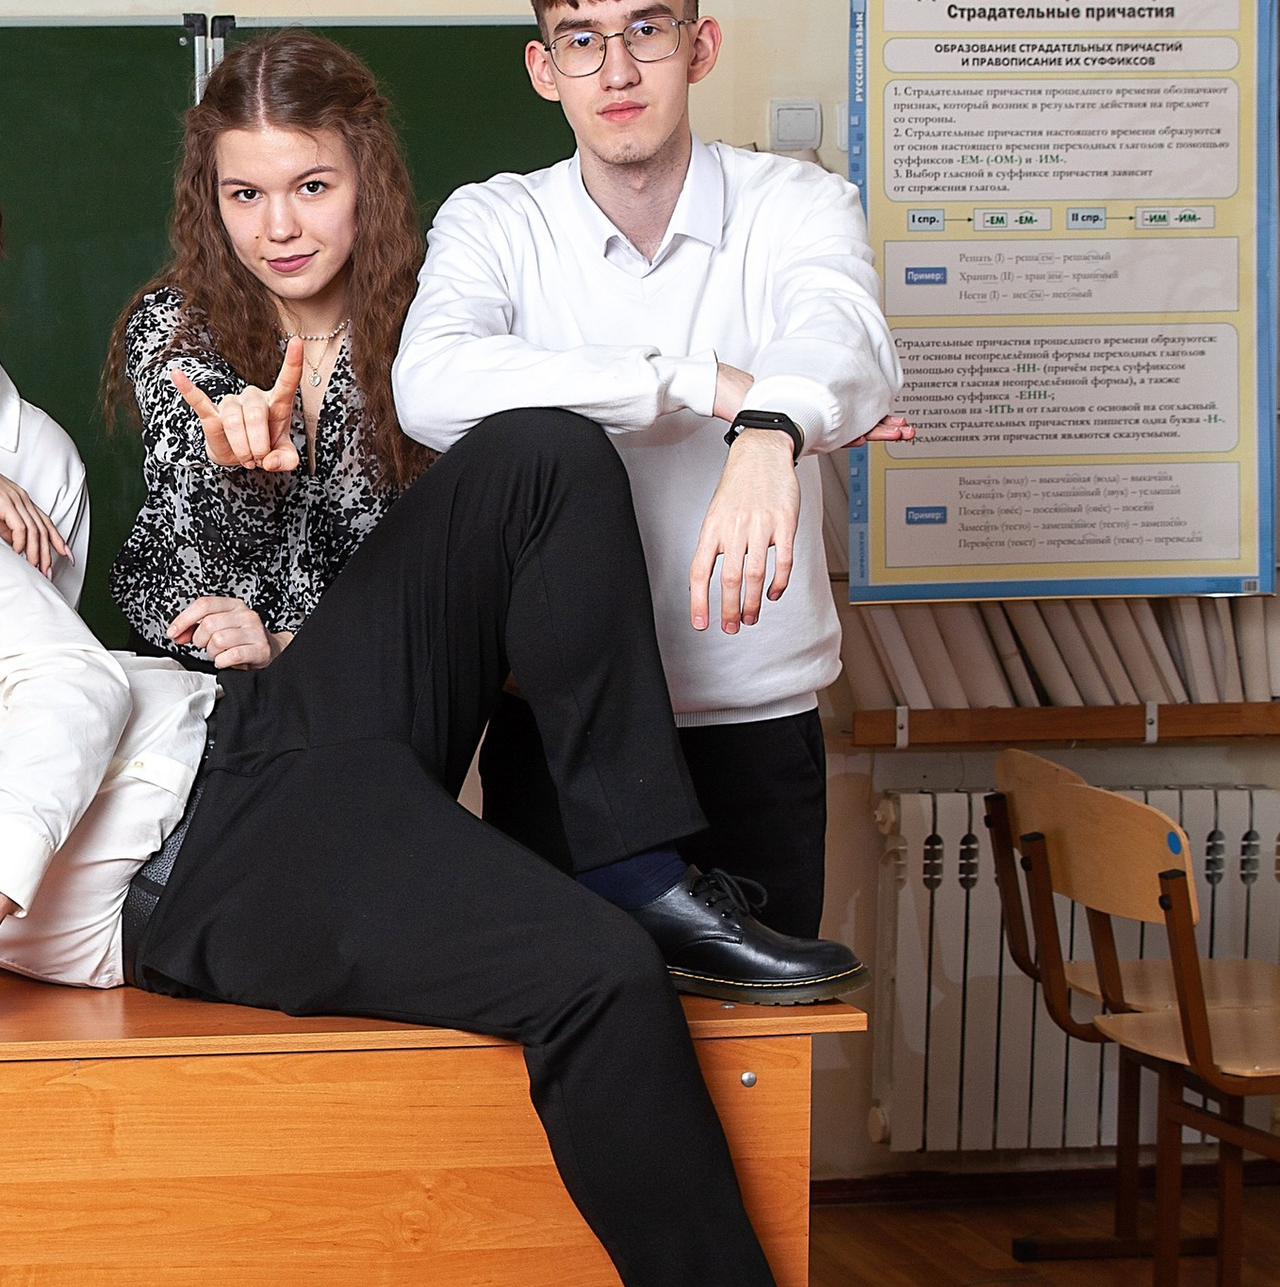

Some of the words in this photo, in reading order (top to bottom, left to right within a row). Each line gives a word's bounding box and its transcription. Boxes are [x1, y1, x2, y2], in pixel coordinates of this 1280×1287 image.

[947, 4, 1080, 21] Страдательные
[1086, 6, 1175, 21] причастия
[855, 13, 864, 45] ЯЗЫК
[934, 44, 1017, 53] ОБРАЗОВАНИЕ
[1019, 43, 1113, 53] СТРАДАТЕЛЬНЫХ
[1116, 41, 1183, 52] ПРИЧАСТИЙ
[961, 58, 969, 66] И
[972, 58, 1062, 66] ПРАВОПИСАНИЕ
[1065, 57, 1080, 66] ИХ
[1084, 57, 1156, 66] СУФФИКСОВ
[855, 48, 864, 102] РУССКИЙ
[893, 87, 901, 96] 1.
[904, 87, 983, 98] Страдательные
[986, 88, 1042, 99] причастия
[1045, 88, 1113, 99] прошедшего
[1116, 88, 1161, 98] времени
[893, 102, 941, 112] признак,
[943, 101, 989, 112] который
[991, 102, 1029, 110] возник
[1040, 101, 1096, 112] результате
[1099, 100, 1147, 110] действия
[1150, 101, 1163, 109] на
[908, 116, 957, 126] стороны.
[893, 128, 902, 137] 2.
[905, 128, 984, 139] Страдательные
[987, 129, 1043, 139] причастия
[1046, 128, 1108, 137] настоящего
[1110, 128, 1156, 139] времени
[908, 143, 938, 151] основ
[941, 143, 1002, 151] настоящего
[1005, 143, 1050, 153] времени
[893, 156, 954, 168] суффиксов
[957, 155, 983, 164] -ЕМ-
[986, 154, 1022, 166] (-ОМ-)
[893, 169, 902, 178] 3.
[905, 168, 941, 180] Выбор
[943, 169, 984, 178] гласной
[996, 169, 1049, 181] суффиксе
[1052, 169, 1108, 180] причастия
[908, 184, 966, 194] спряжения
[969, 184, 1010, 192] глагола.
[917, 215, 940, 225] спр.
[1081, 214, 1103, 224] спр.
[907, 271, 944, 281] Пример:
[894, 338, 973, 350] Страдательные
[976, 339, 1030, 350] причастия
[1033, 338, 1101, 349] прошедшего
[1103, 337, 1148, 347] времени
[923, 353, 962, 361] основы
[965, 350, 1049, 362] неопределённой
[1052, 349, 1090, 361] формы
[1093, 350, 1157, 361] переходных
[903, 367, 954, 375] помощью
[956, 365, 1009, 377] суффикса
[1012, 363, 1040, 373] -НН-
[1043, 363, 1087, 375] (причём
[960, 379, 1000, 388] гласная
[1003, 377, 1088, 389] неопределённой
[1090, 376, 1137, 388] формы),
[903, 394, 954, 403] помощью
[956, 392, 1009, 405] суффикса
[923, 407, 967, 415] глаголов
[985, 404, 1014, 414] -ИТЬ
[1041, 405, 1086, 413] глаголов
[1096, 402, 1141, 412] основой
[908, 421, 947, 431] ратких
[950, 420, 1026, 432] страдательных
[1029, 418, 1091, 430] причастиях
[1093, 417, 1139, 426] пишется
[912, 434, 980, 445] редложениях
[982, 433, 1000, 441] эти
[1003, 432, 1058, 443] причастия
[908, 511, 944, 521] Пример:
